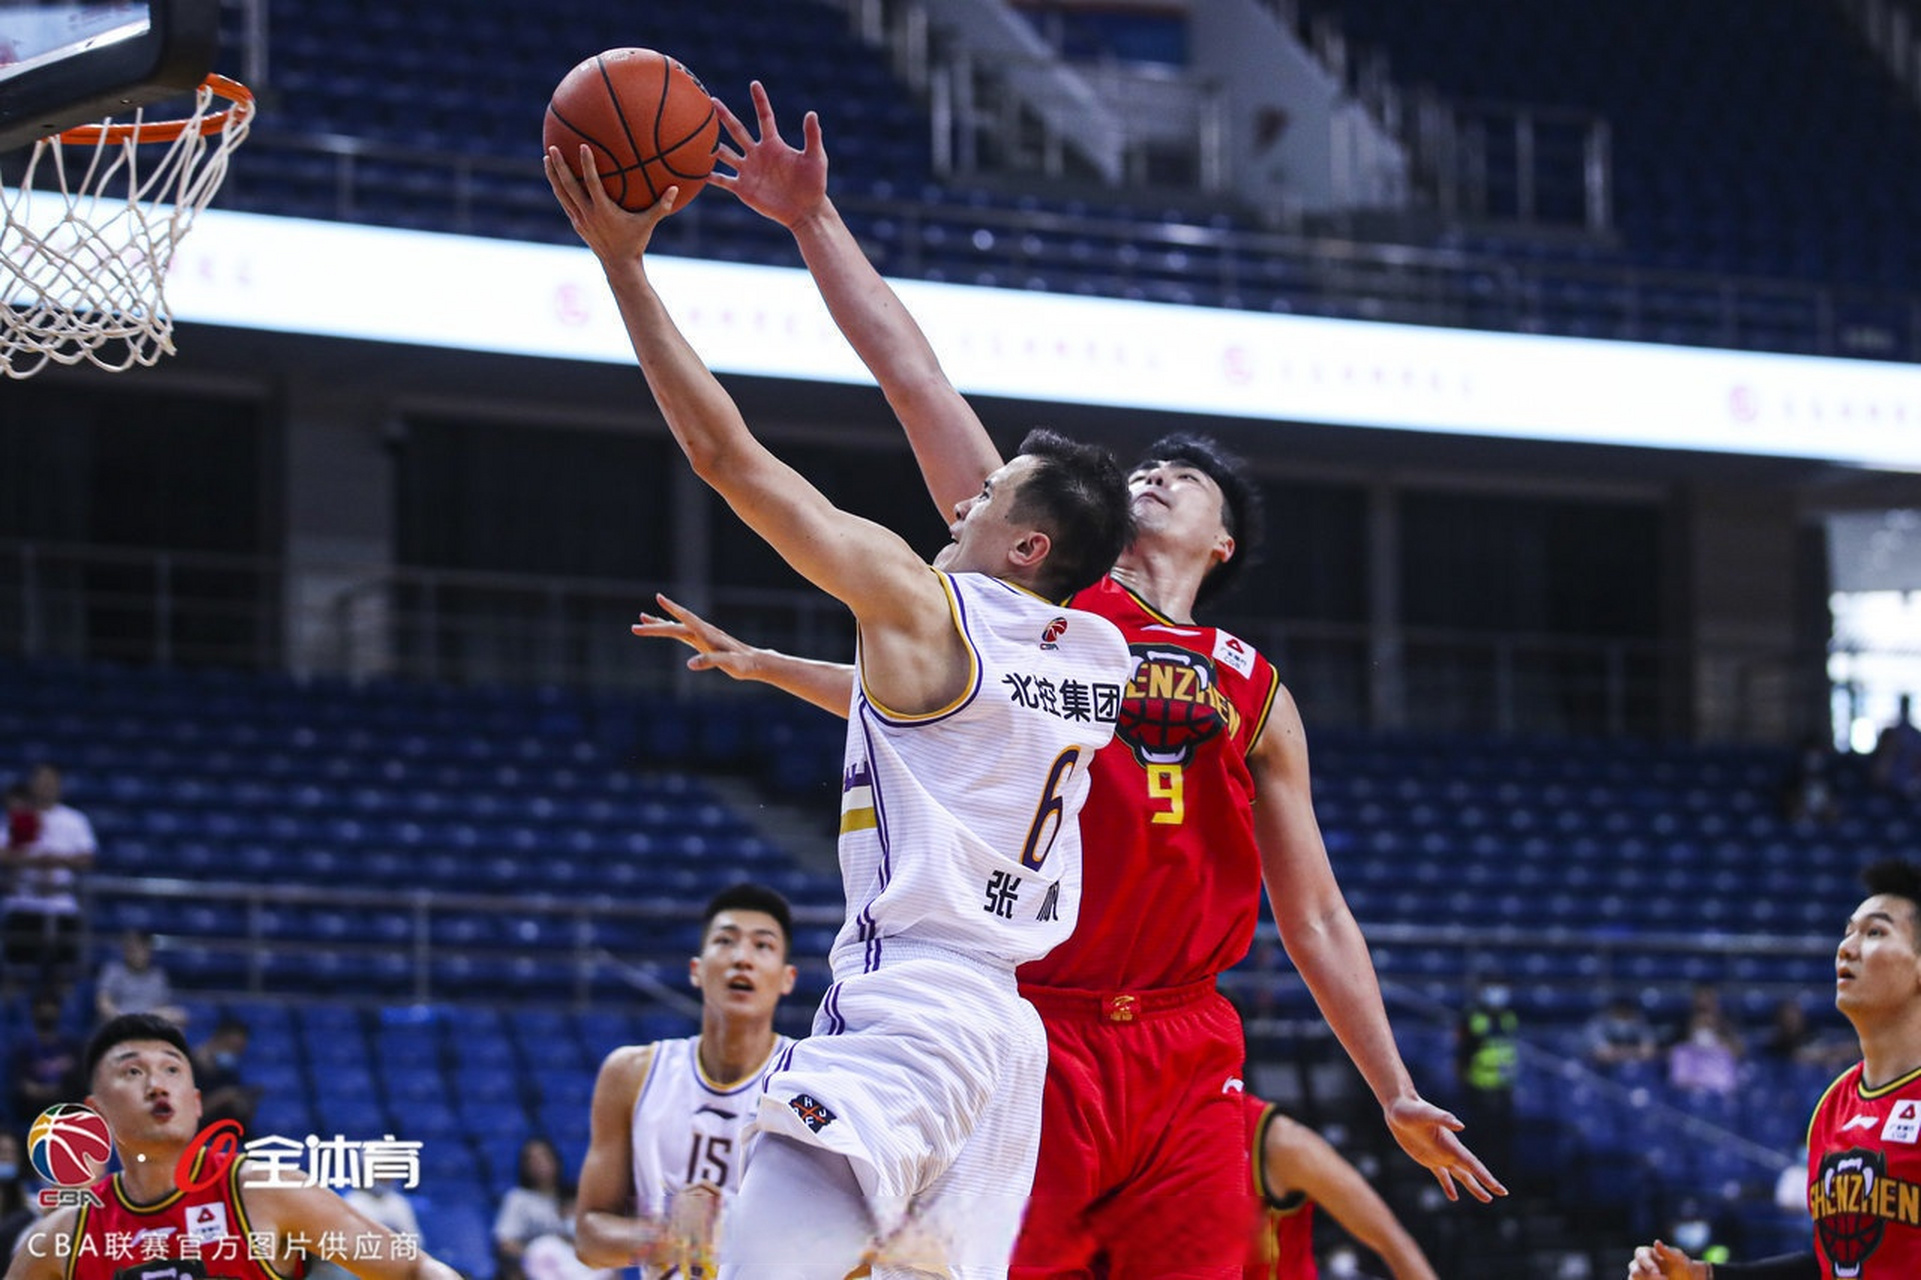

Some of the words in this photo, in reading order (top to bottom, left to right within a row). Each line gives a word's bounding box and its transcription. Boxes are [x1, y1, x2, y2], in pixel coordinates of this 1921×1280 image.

[1001, 672, 1121, 724] 北控集团
[1126, 663, 1241, 741] ENZHEN
[1019, 744, 1081, 873] 6
[1147, 764, 1184, 825] 9
[687, 1133, 732, 1188] 15
